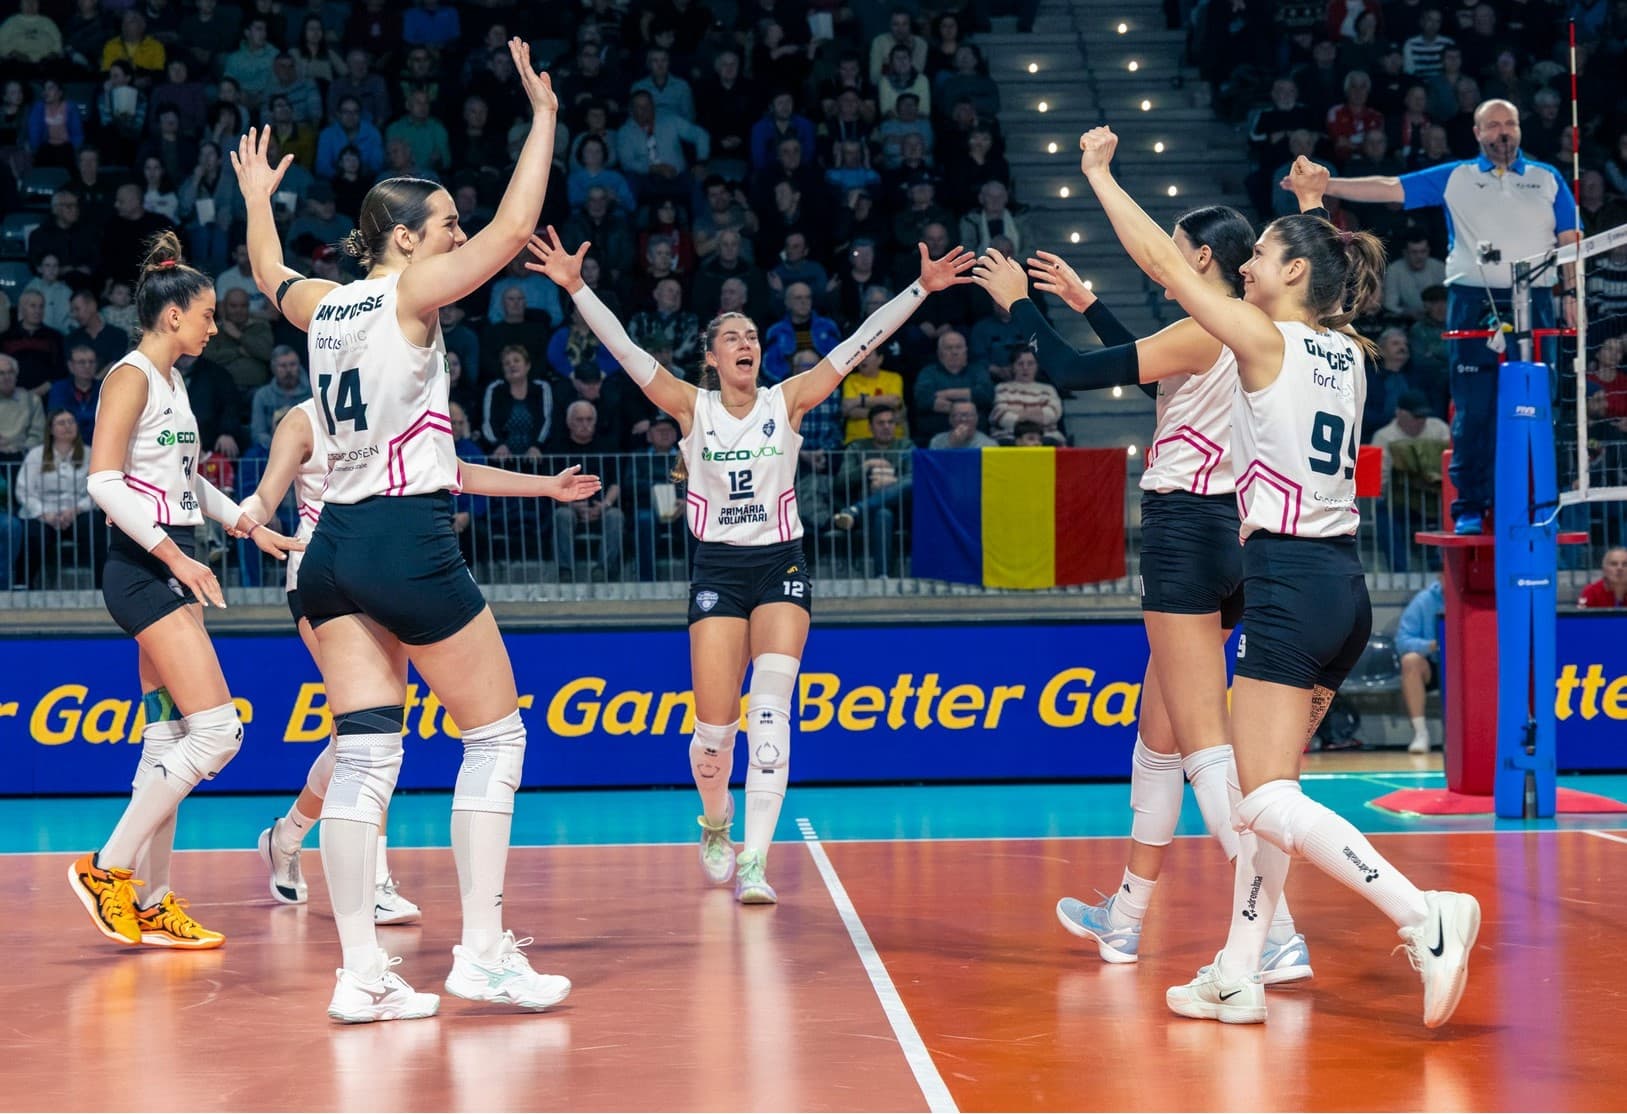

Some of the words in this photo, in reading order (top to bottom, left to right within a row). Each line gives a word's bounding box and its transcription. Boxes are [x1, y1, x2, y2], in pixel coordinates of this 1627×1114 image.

[318, 367, 368, 435] 14
[176, 431, 196, 444] ECO
[713, 446, 785, 462] ECOVOL
[728, 469, 753, 492] 12
[718, 512, 768, 525] VOLUNTARI
[783, 580, 804, 598] 12
[798, 672, 1026, 733] Better
[1554, 664, 1627, 721] tte
